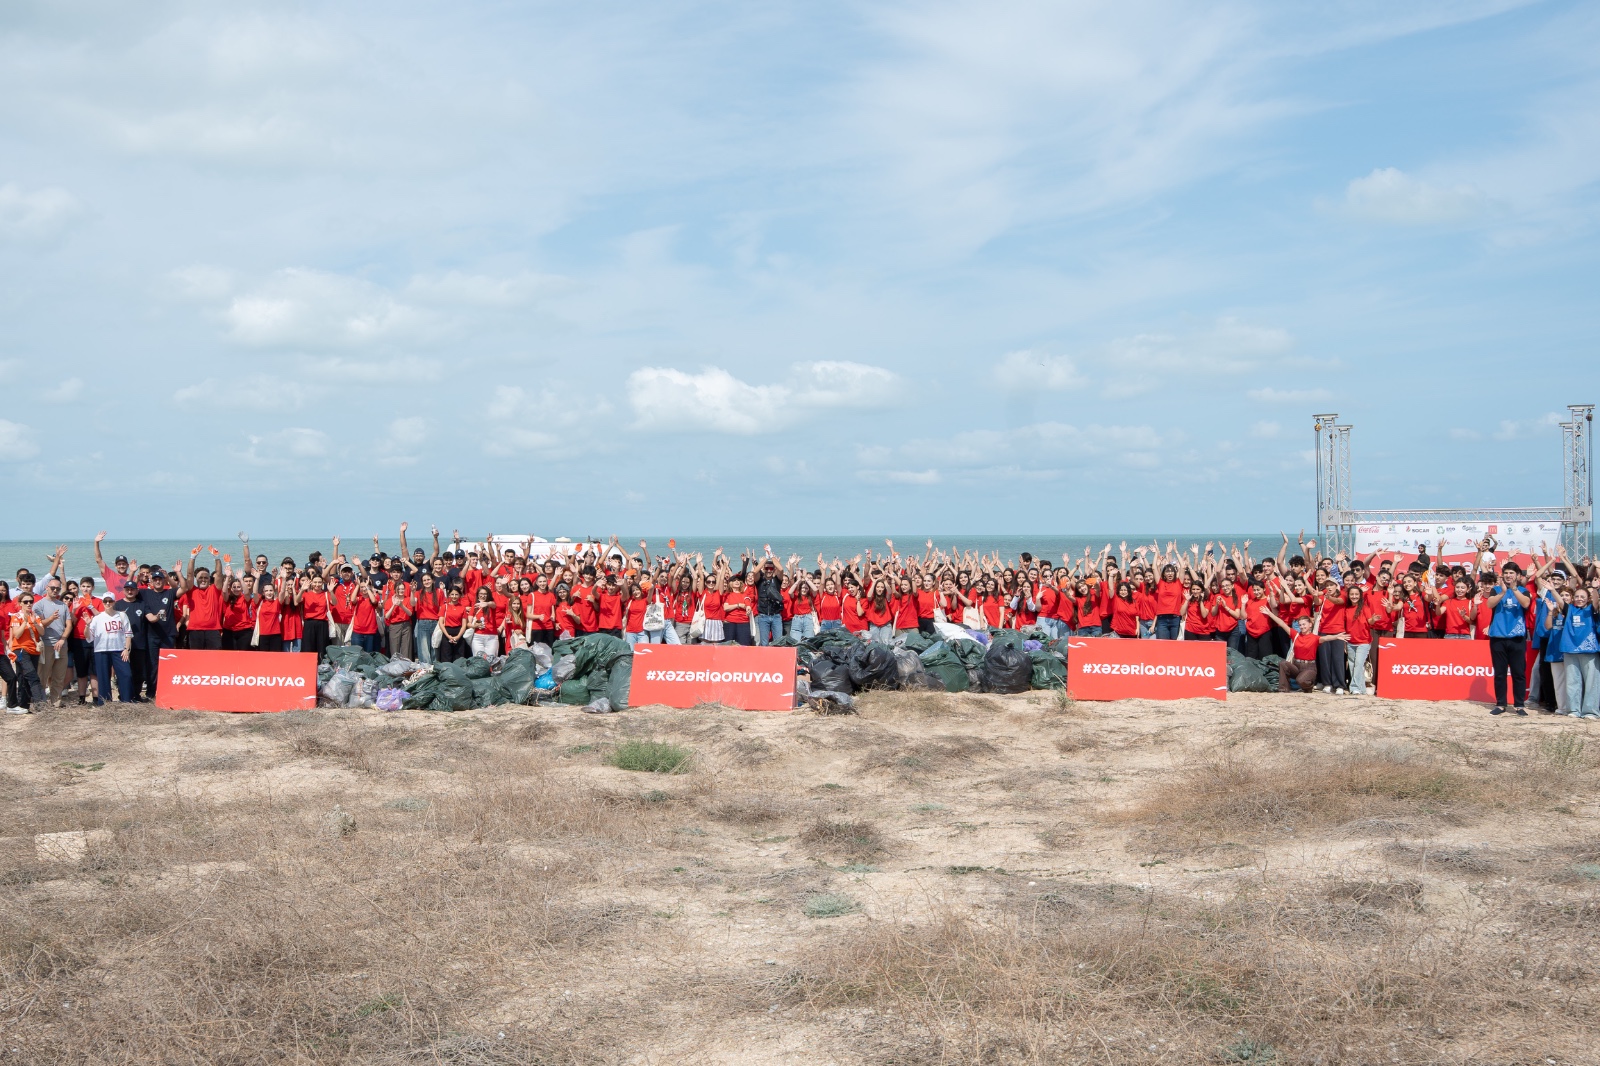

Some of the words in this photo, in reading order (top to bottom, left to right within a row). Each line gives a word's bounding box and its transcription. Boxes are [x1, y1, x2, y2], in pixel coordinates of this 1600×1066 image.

[105, 620, 123, 632] USA
[646, 669, 784, 683] #XƏZƏRİQORUYAQ
[1082, 662, 1216, 678] #XƏZƏRİQORUYAQ
[1391, 664, 1512, 677] #XƏZƏRİQORU
[172, 674, 306, 687] #XƏZƏRİQORUYAQ
